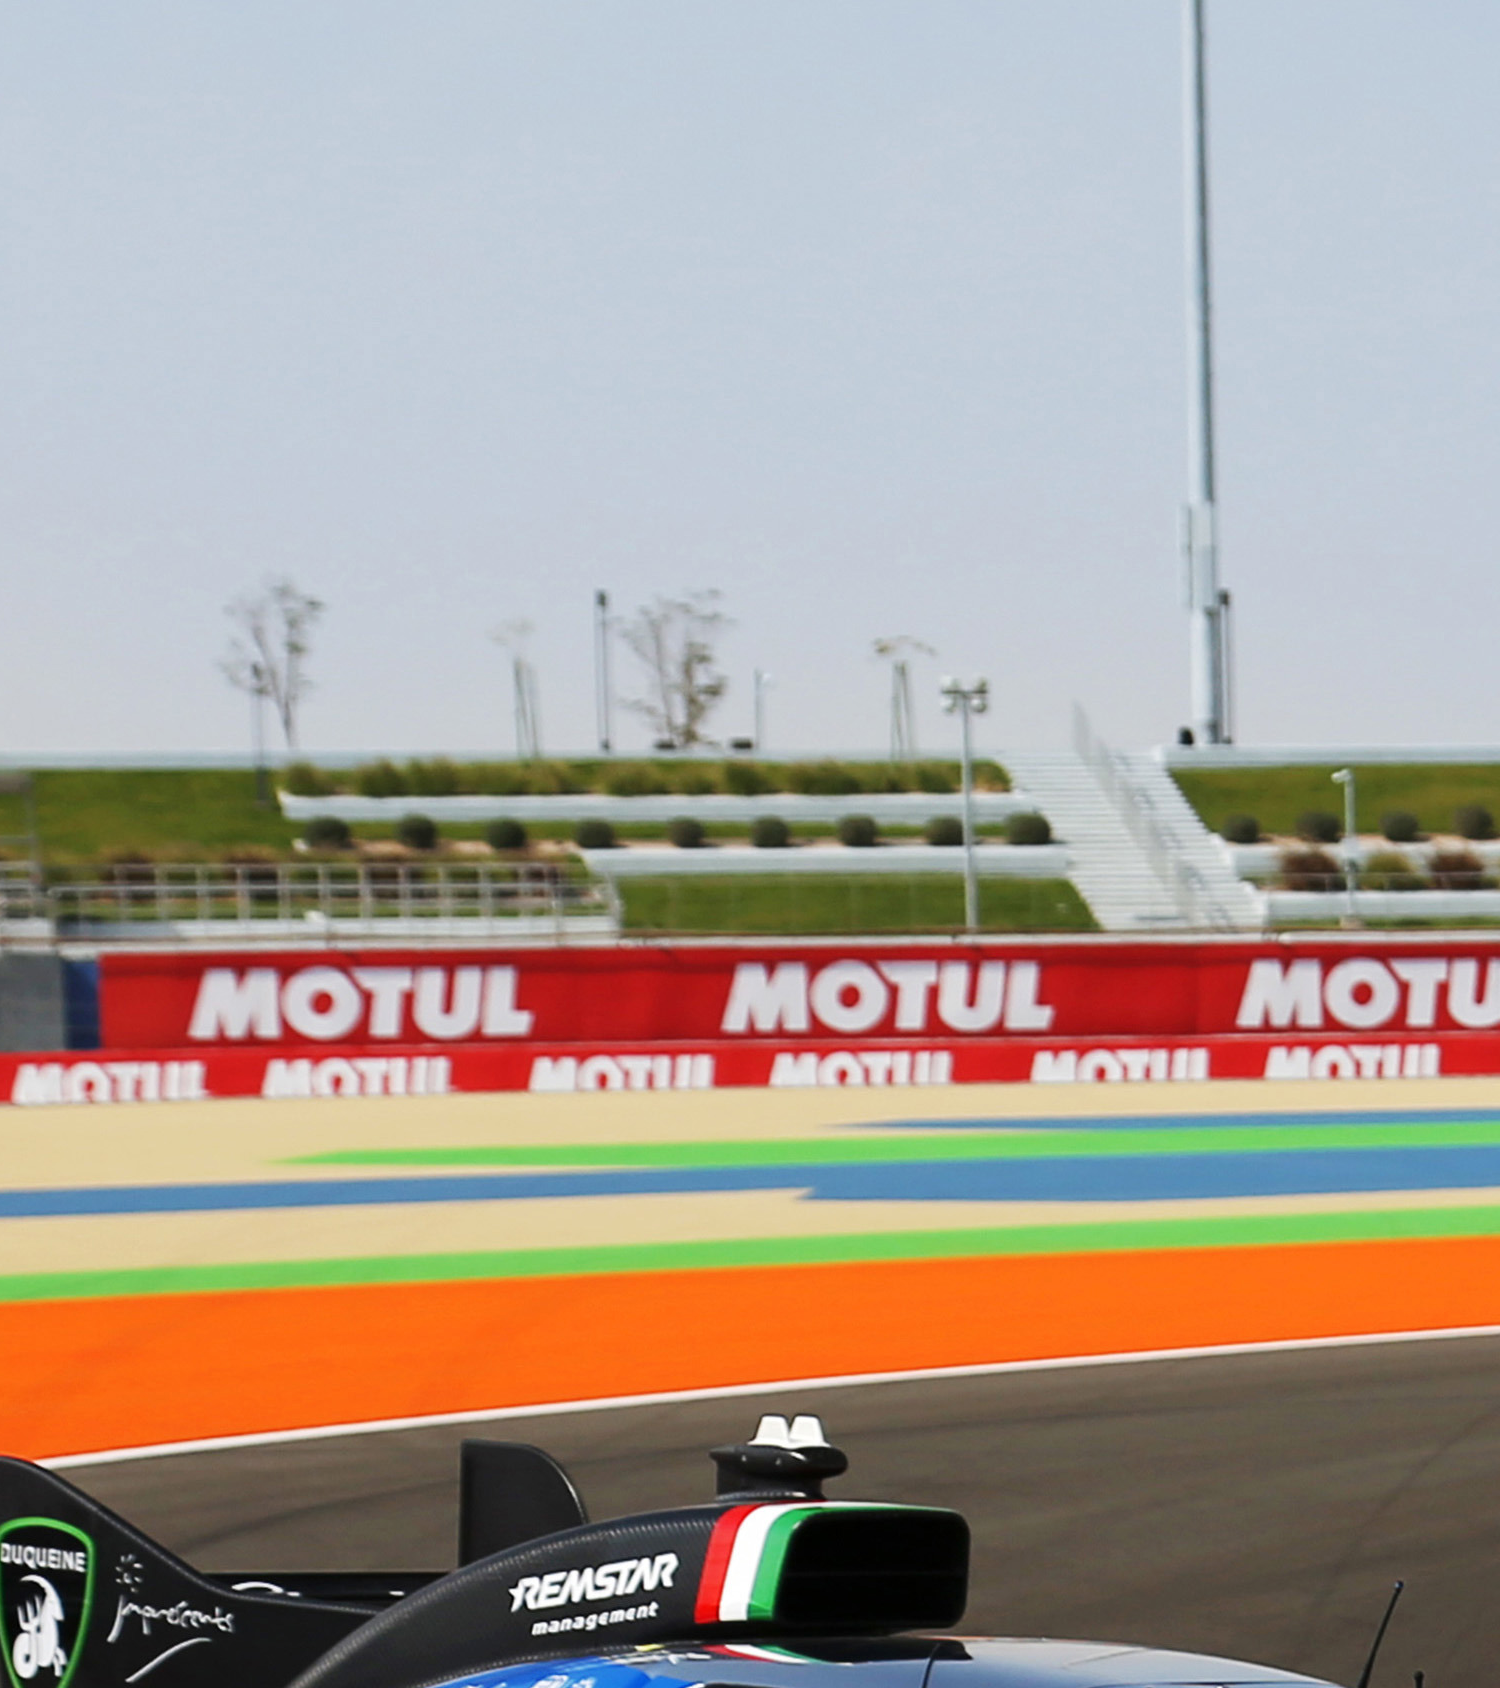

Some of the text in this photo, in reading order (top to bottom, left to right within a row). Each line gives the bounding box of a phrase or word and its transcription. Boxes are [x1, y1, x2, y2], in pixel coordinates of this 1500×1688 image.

[188, 966, 533, 1040] MOTUL
[721, 960, 1055, 1034] MOTUL
[0, 1542, 87, 1573] DUQUEINE
[509, 1552, 679, 1612] REMSTAR
[531, 1600, 660, 1637] management
